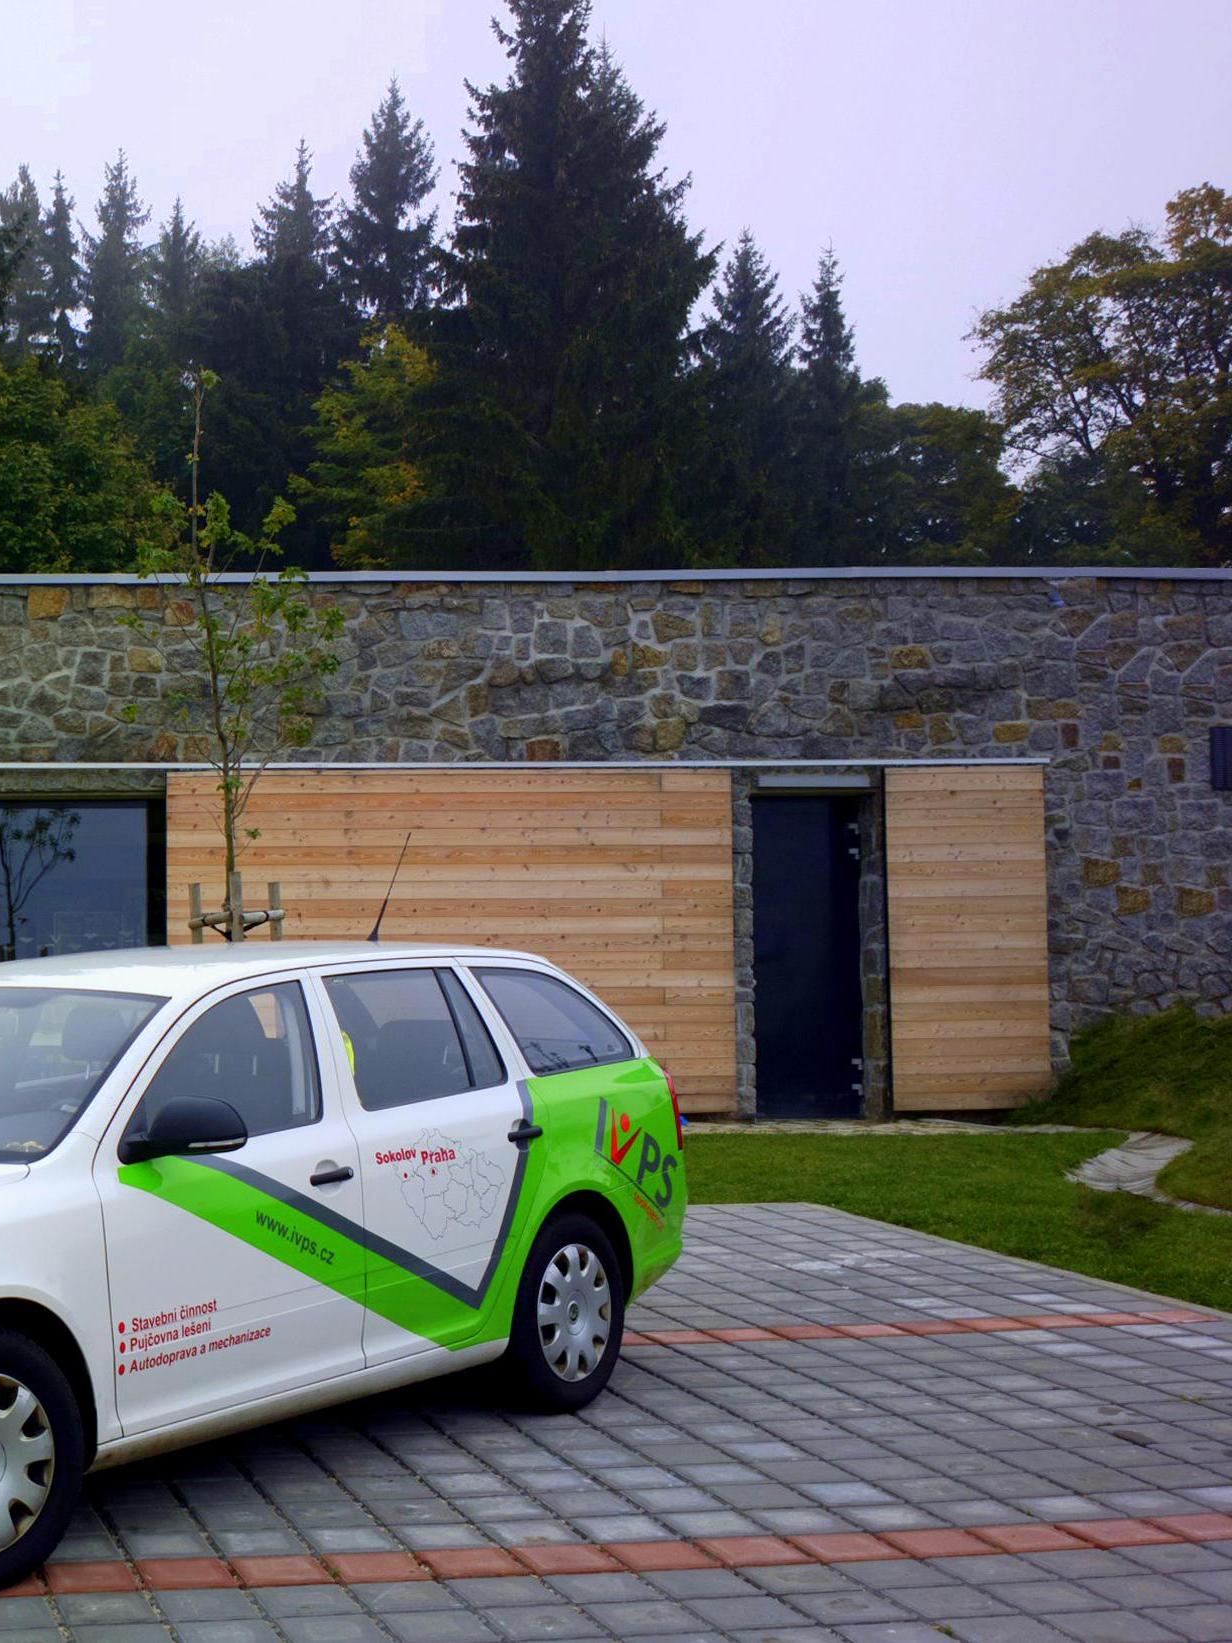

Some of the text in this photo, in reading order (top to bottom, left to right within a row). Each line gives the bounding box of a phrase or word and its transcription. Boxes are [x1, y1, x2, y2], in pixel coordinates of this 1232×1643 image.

[375, 1147, 417, 1165] Sokolov
[420, 1147, 456, 1165] Praha
[255, 1209, 335, 1265] www.ivps.cz
[129, 1326, 272, 1374] Autodoprava a mechanizace
